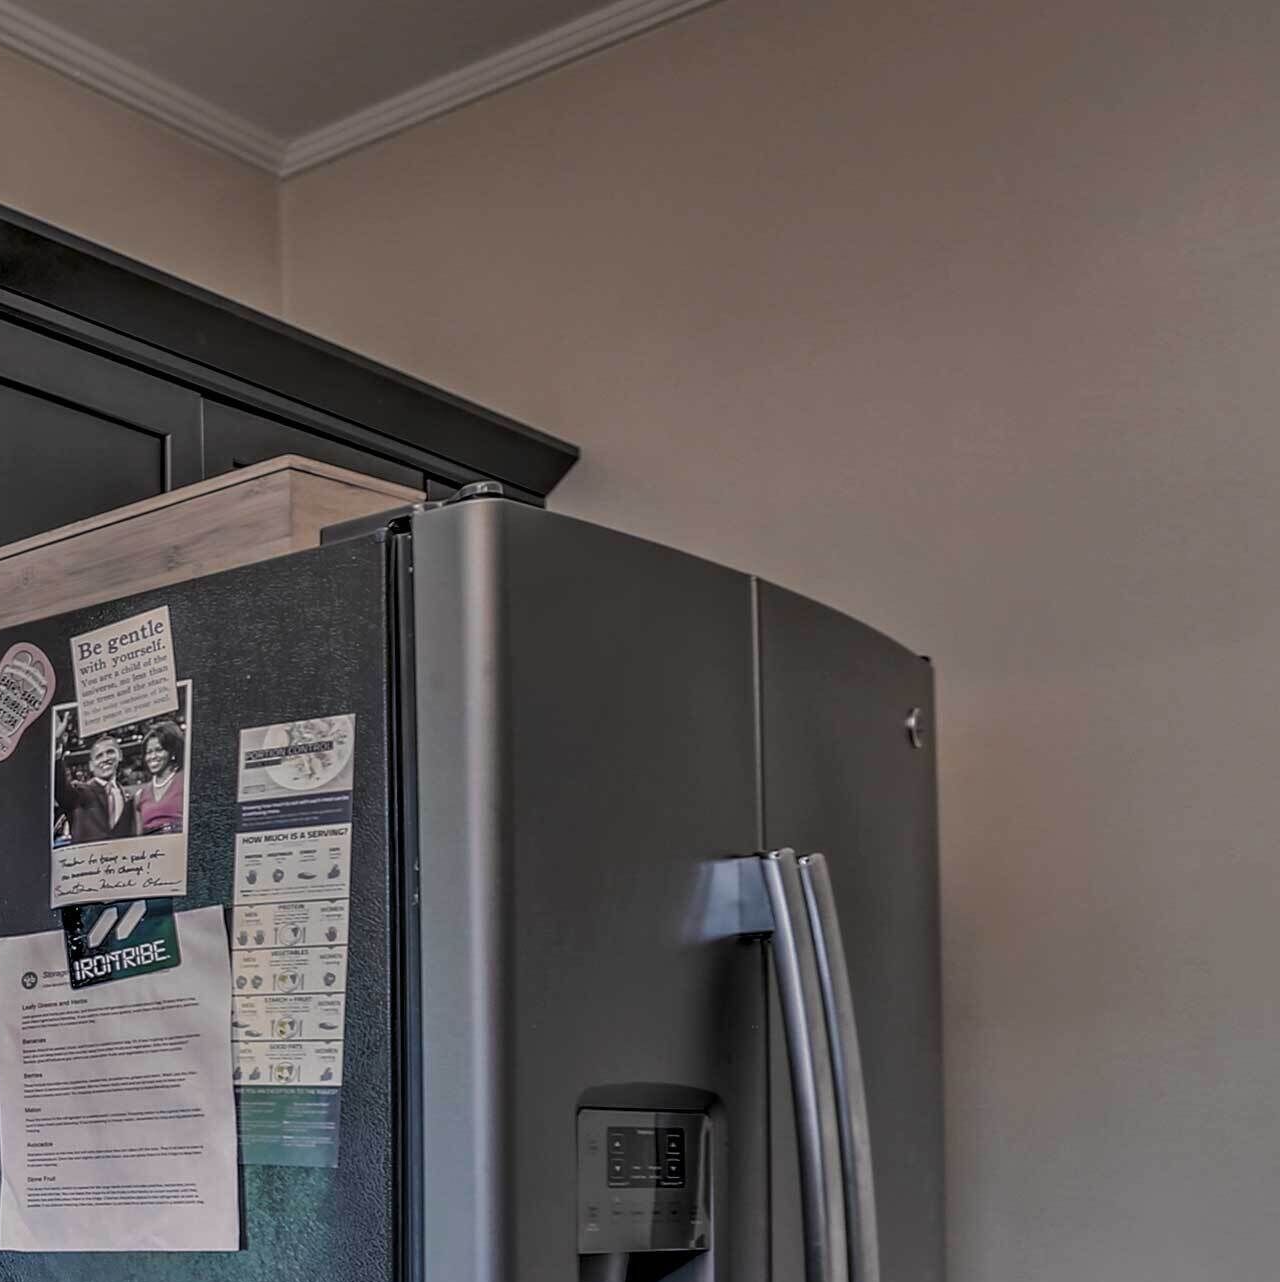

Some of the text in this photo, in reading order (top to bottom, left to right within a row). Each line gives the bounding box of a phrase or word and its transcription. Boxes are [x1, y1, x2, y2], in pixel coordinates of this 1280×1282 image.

[78, 620, 164, 660] Be gentle
[80, 639, 166, 676] with yourself.
[81, 678, 98, 687] You
[100, 673, 112, 681] are
[121, 662, 141, 675] child
[143, 659, 152, 667] of
[154, 654, 168, 662] the
[149, 665, 169, 676] than
[117, 687, 131, 697] and
[133, 682, 146, 692] the
[244, 742, 333, 761] PORTION CONTROL
[242, 836, 263, 844] HOW
[264, 833, 288, 842] MUCH
[290, 832, 298, 840] IS
[307, 828, 349, 838] SERVING?
[149, 849, 166, 859] of
